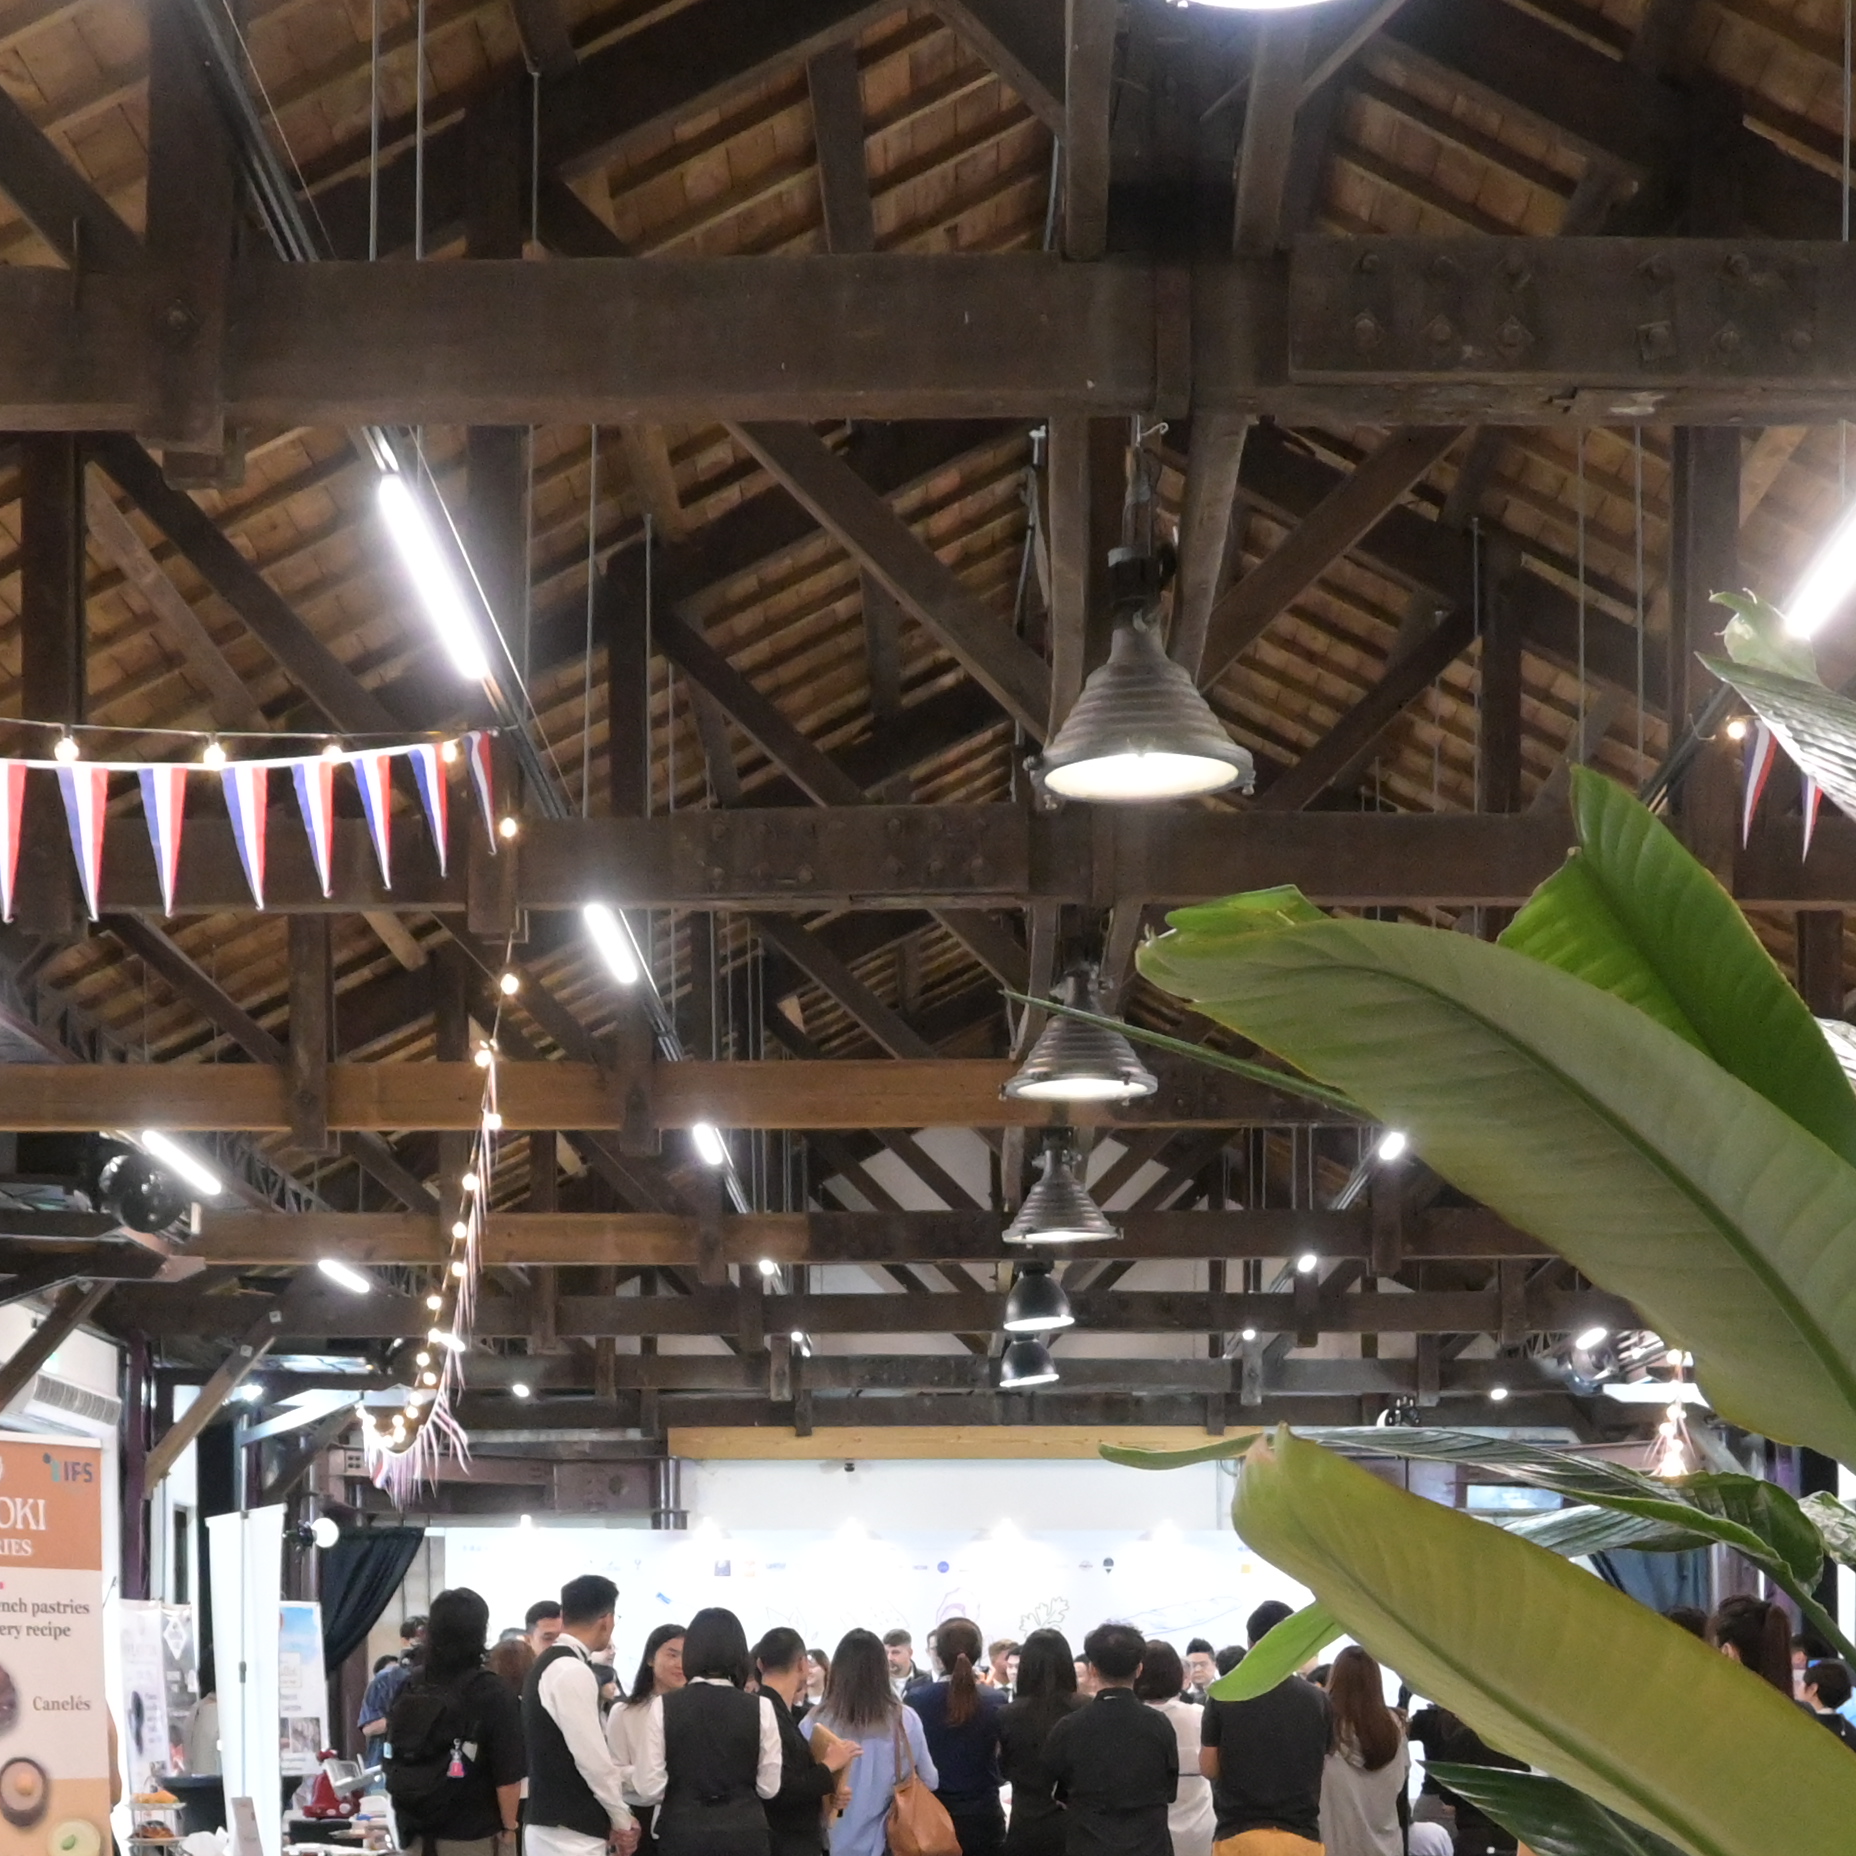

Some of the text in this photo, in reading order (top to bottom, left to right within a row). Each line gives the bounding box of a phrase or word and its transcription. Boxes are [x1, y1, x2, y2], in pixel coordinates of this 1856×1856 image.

[64, 1461, 92, 1483] IFS
[32, 1599, 90, 1617] pastries
[26, 1623, 71, 1641] recipe
